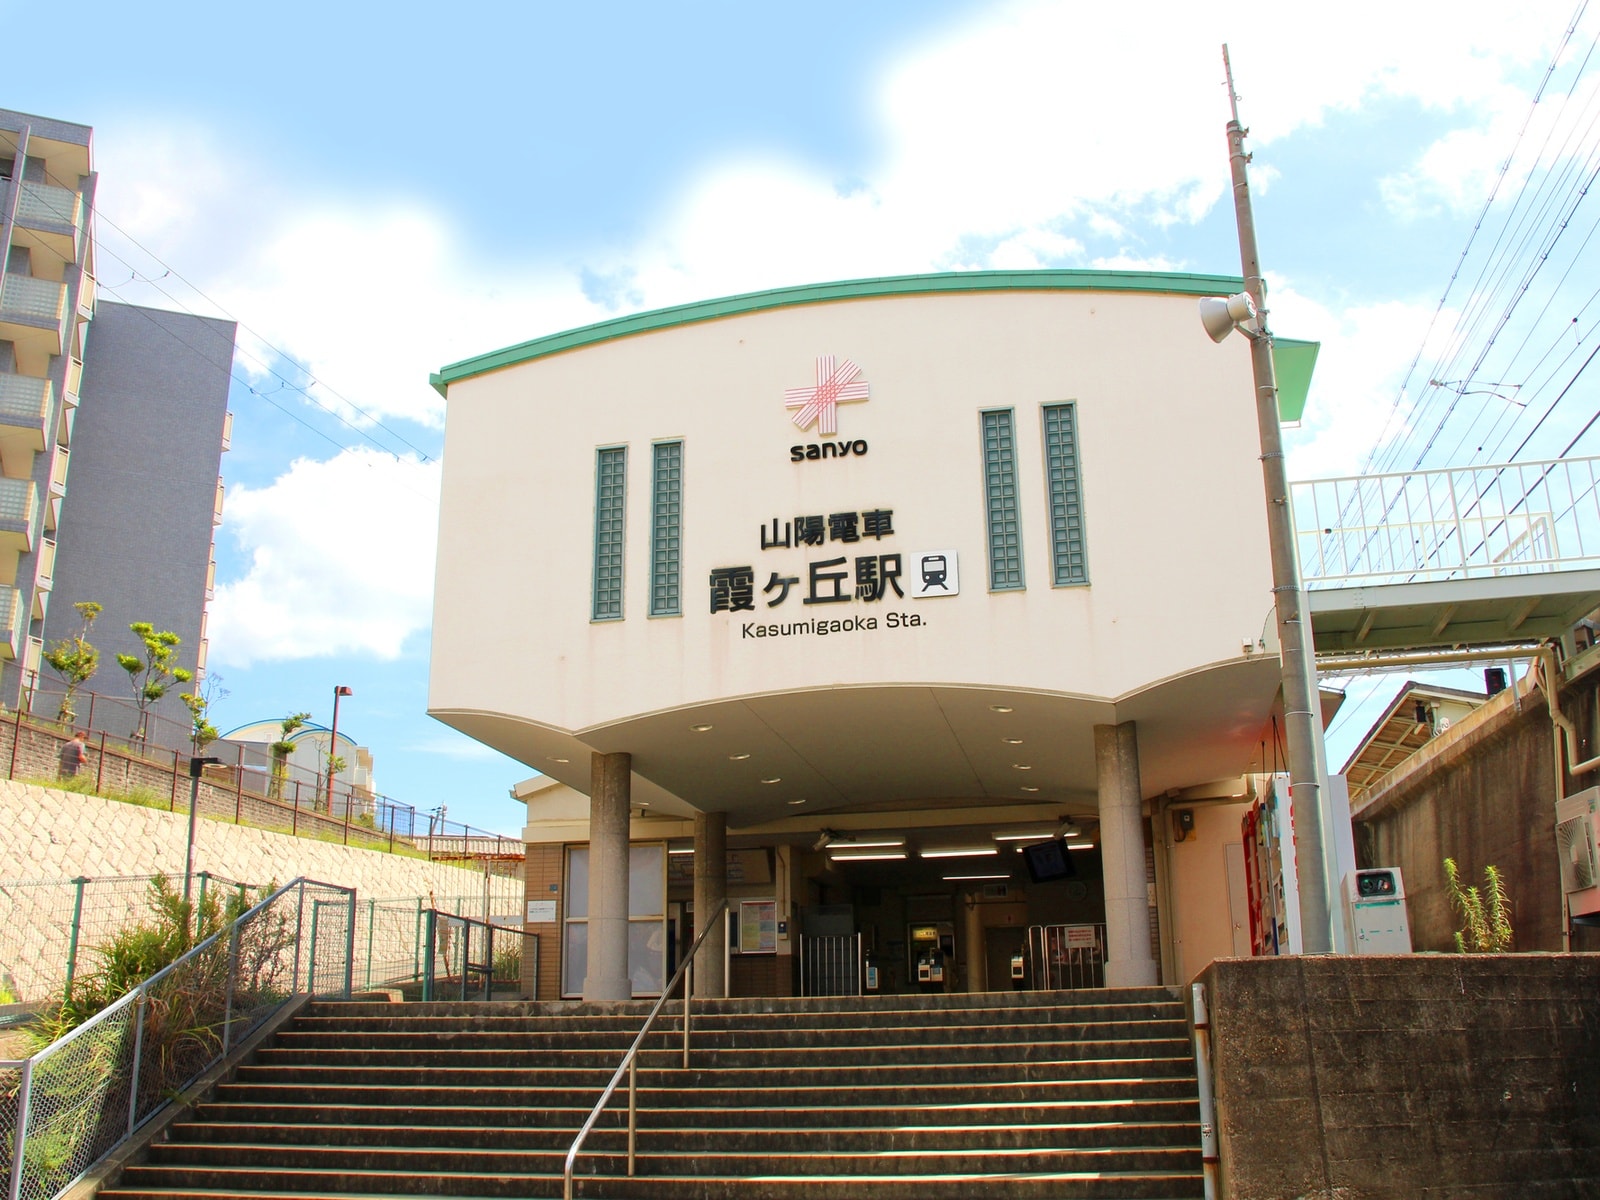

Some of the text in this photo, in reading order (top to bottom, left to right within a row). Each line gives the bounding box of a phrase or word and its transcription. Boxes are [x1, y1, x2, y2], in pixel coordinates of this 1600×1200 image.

[790, 439, 868, 461] sanyo
[760, 509, 895, 551] 山陽電車
[742, 612, 927, 639] Kasumigaoka Sta.
